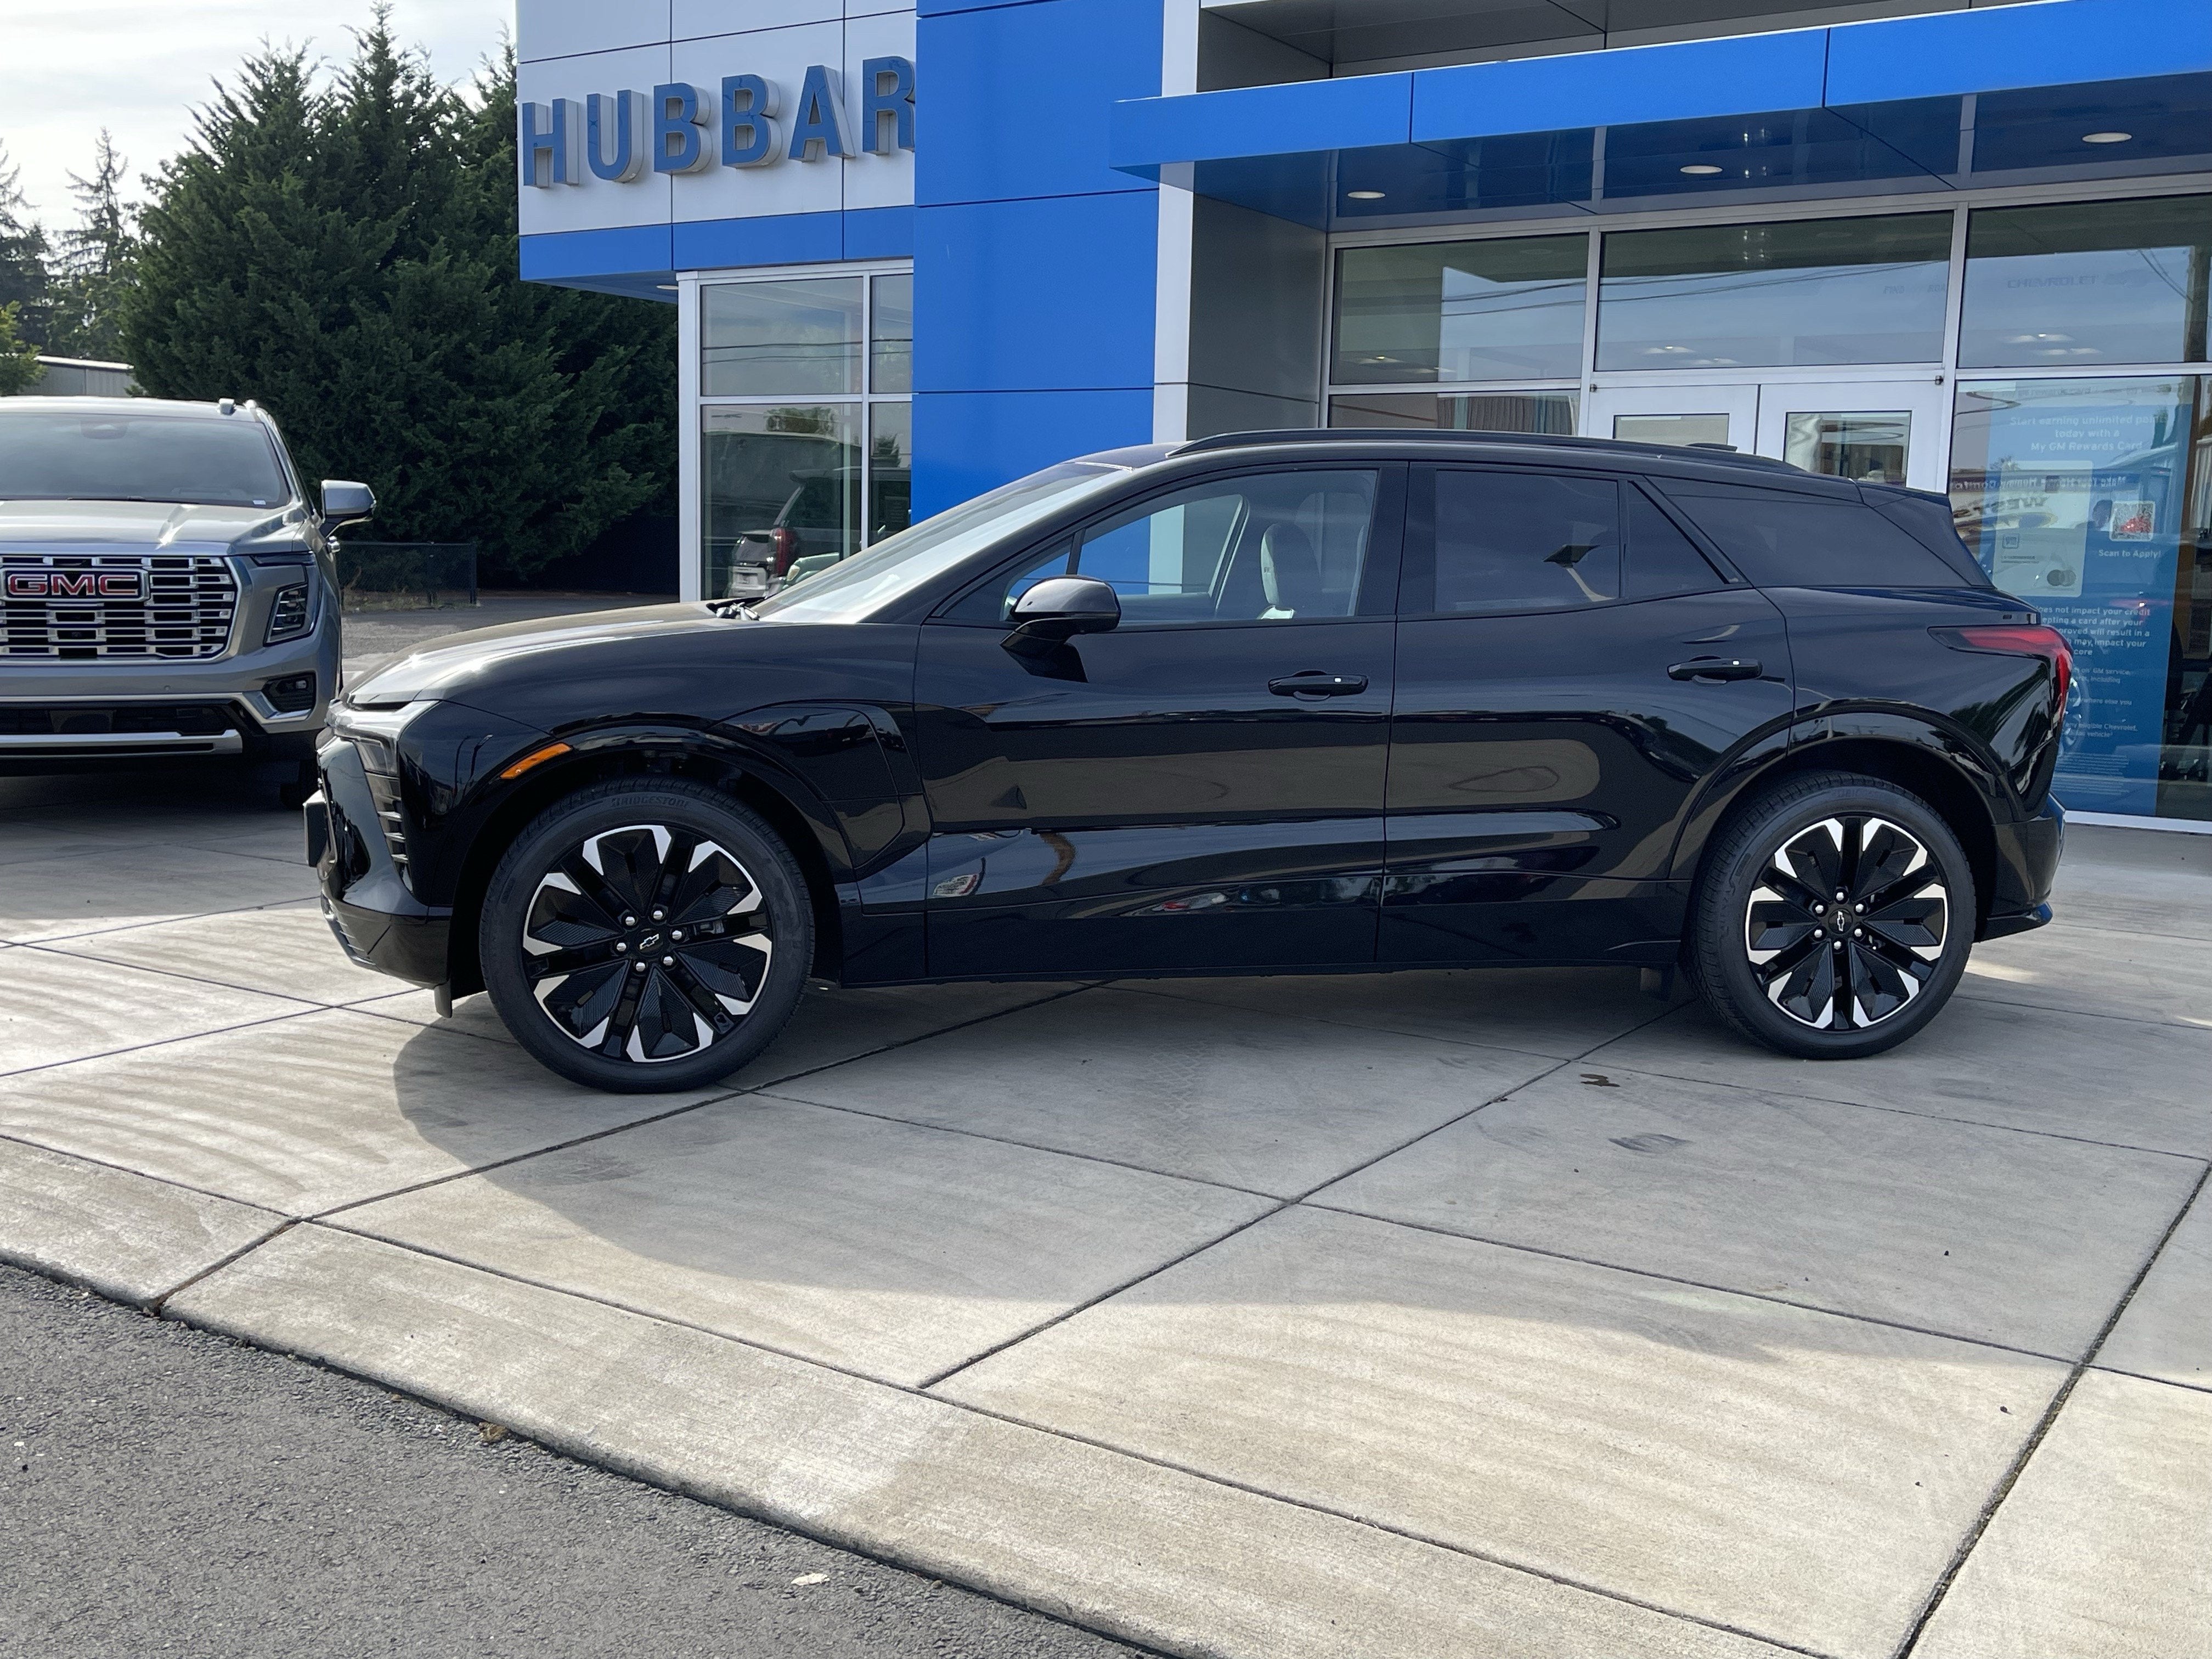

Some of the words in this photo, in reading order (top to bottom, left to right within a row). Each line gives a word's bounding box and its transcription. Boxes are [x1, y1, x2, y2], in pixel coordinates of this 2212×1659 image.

[522, 56, 915, 188] HUBBAR
[2007, 275, 2099, 289] CHEVROLET
[2010, 416, 2036, 426] Start
[2039, 417, 2079, 426] earning
[2083, 415, 2133, 425] unlimited
[2056, 429, 2084, 438] today
[2087, 429, 2111, 438] with
[2031, 442, 2045, 453] My
[2049, 442, 2066, 451] GM
[2069, 441, 2114, 451] Rewards
[2118, 441, 2142, 450] Card
[2133, 550, 2161, 558] Apply!
[8, 574, 138, 595] GMC
[2072, 607, 2100, 615] impact
[2125, 607, 2150, 616] credit
[2095, 639, 2124, 647] impact
